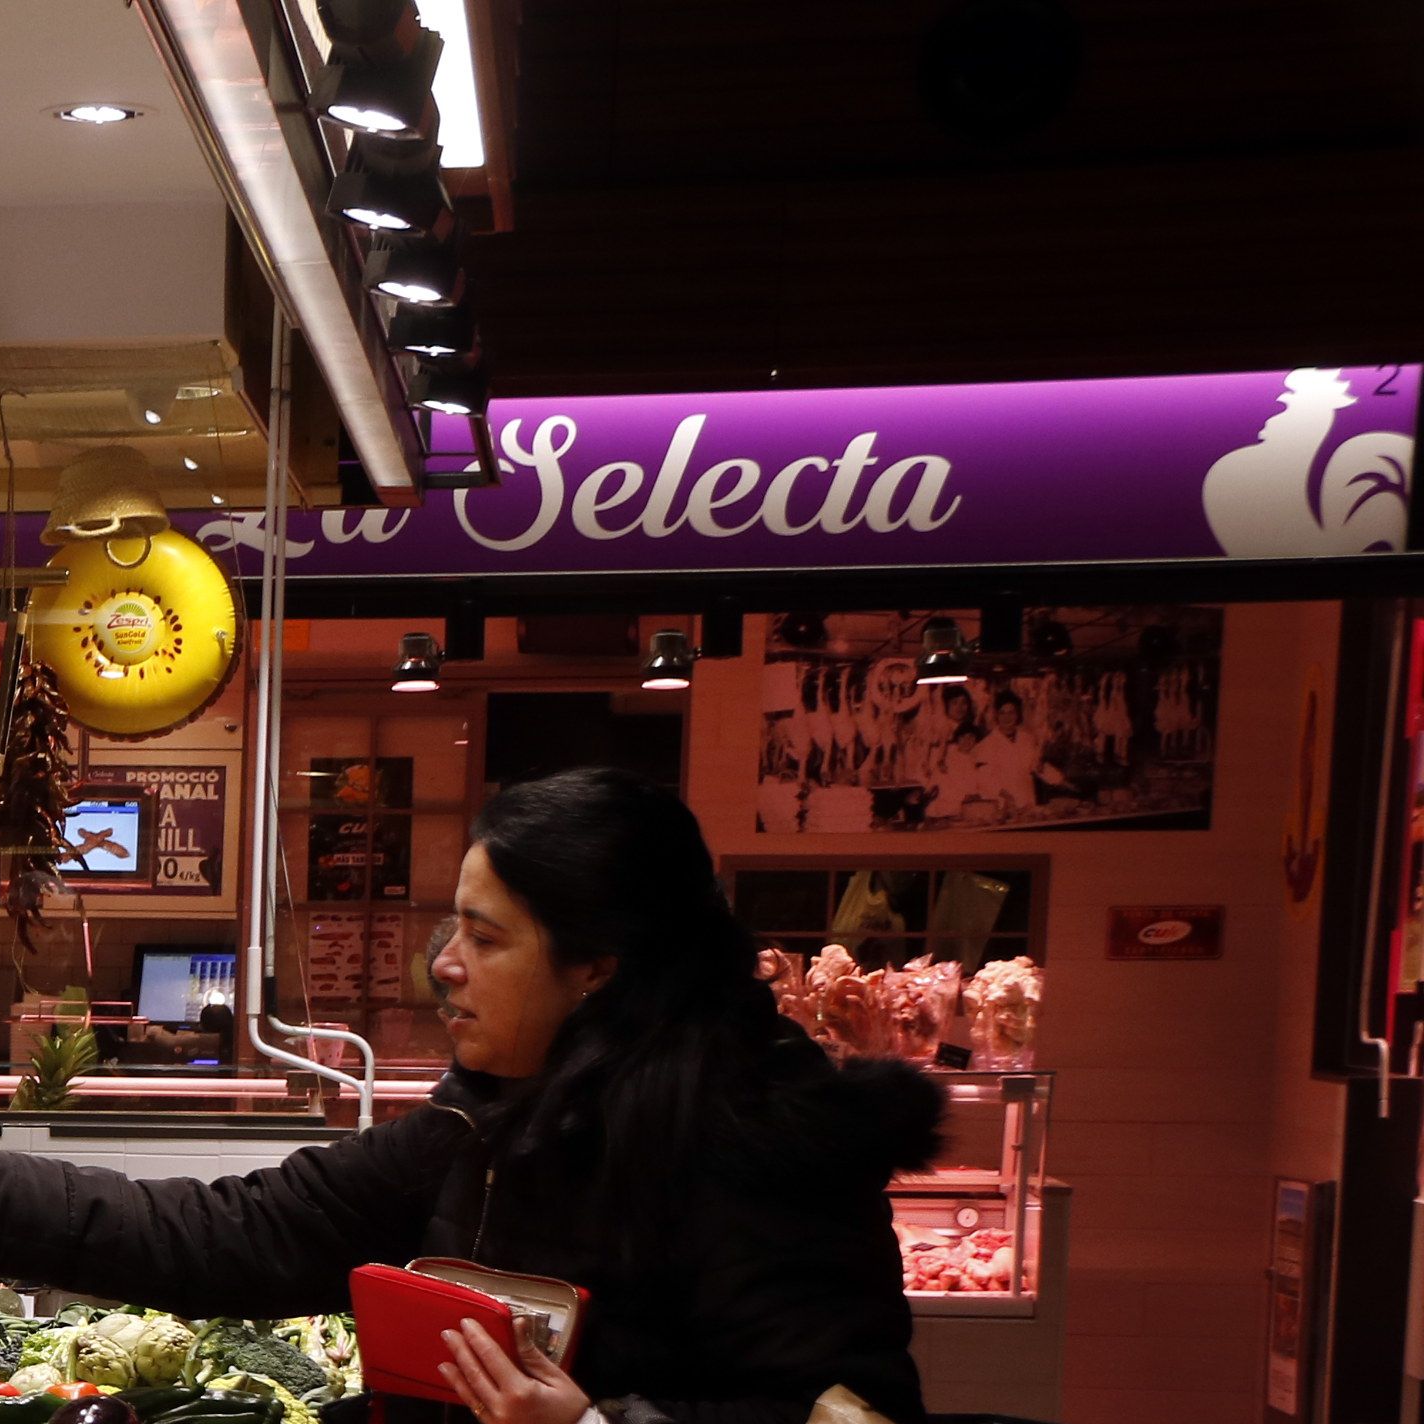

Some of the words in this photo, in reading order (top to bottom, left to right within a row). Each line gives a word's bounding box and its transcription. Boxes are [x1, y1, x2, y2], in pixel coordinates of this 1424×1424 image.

[452, 412, 963, 553] Selecta
[107, 614, 151, 629] Zespri
[114, 630, 146, 639] SunGold
[125, 770, 220, 784] PROMOCIÓ
